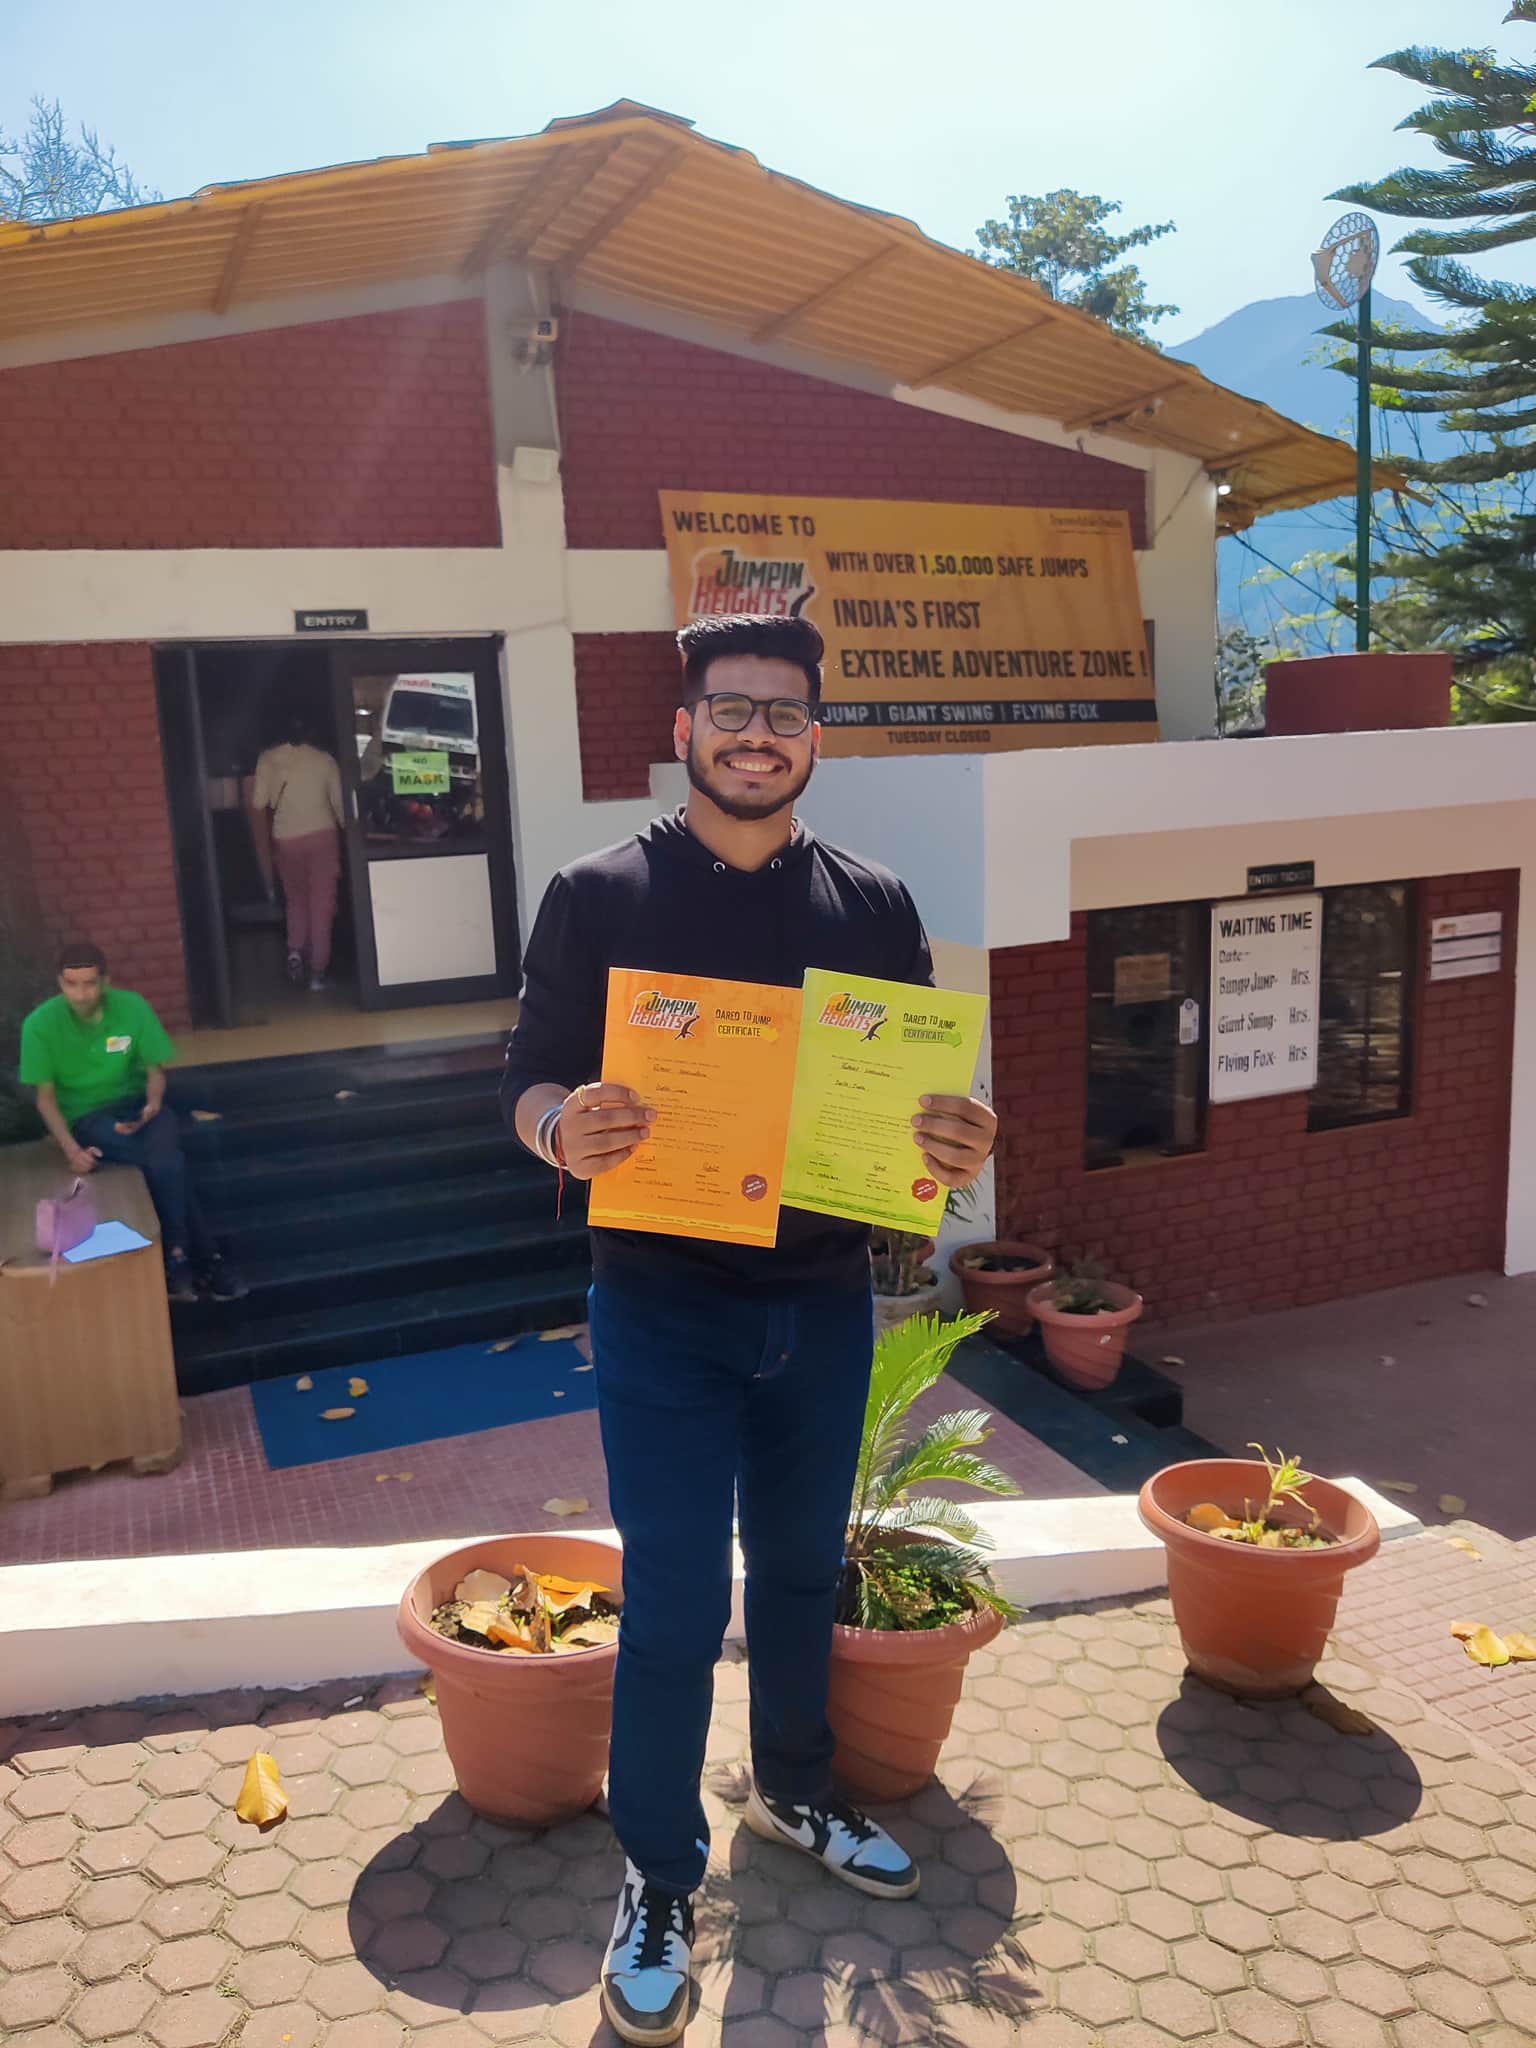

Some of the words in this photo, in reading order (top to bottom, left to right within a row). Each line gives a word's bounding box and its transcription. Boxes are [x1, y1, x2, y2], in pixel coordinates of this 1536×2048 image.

[672, 511, 783, 536] WELCOME
[788, 515, 816, 537] TO
[715, 550, 804, 588] JUMPIN
[826, 551, 868, 573] WITH
[873, 553, 916, 574] OVER
[996, 556, 1035, 577] SAFE
[1039, 557, 1089, 578] JUMPS
[303, 615, 357, 627] ENTRY
[833, 599, 918, 629] INDIA'S
[923, 601, 981, 629] FIRST
[840, 649, 946, 678] EXTREME
[952, 649, 1077, 678] ADVENTURE
[1080, 649, 1136, 677] ZONE
[822, 705, 869, 723] JUMP
[888, 705, 938, 721] GIANT
[942, 704, 995, 721] SWING
[1012, 703, 1066, 721] FLYING
[1069, 703, 1099, 719] FOX
[887, 730, 942, 743] TUESDAY
[945, 729, 991, 743] CLOSED
[1219, 915, 1276, 938] WAITING
[1279, 911, 1313, 932] TIME
[630, 1003, 685, 1028] HEIGHTS
[644, 991, 698, 1016] JUMPIN
[835, 993, 887, 1018] JUMPIN
[715, 1008, 741, 1021] DARED
[743, 1010, 752, 1021] TO
[752, 1014, 772, 1025] JUMP
[818, 1003, 873, 1031] HEIGHTS
[903, 1012, 927, 1025] DARED
[929, 1014, 939, 1025] TO
[937, 1019, 957, 1029] JUMP
[717, 1024, 761, 1037] CERTIFICATE
[903, 1027, 946, 1041] CERTIFICATE
